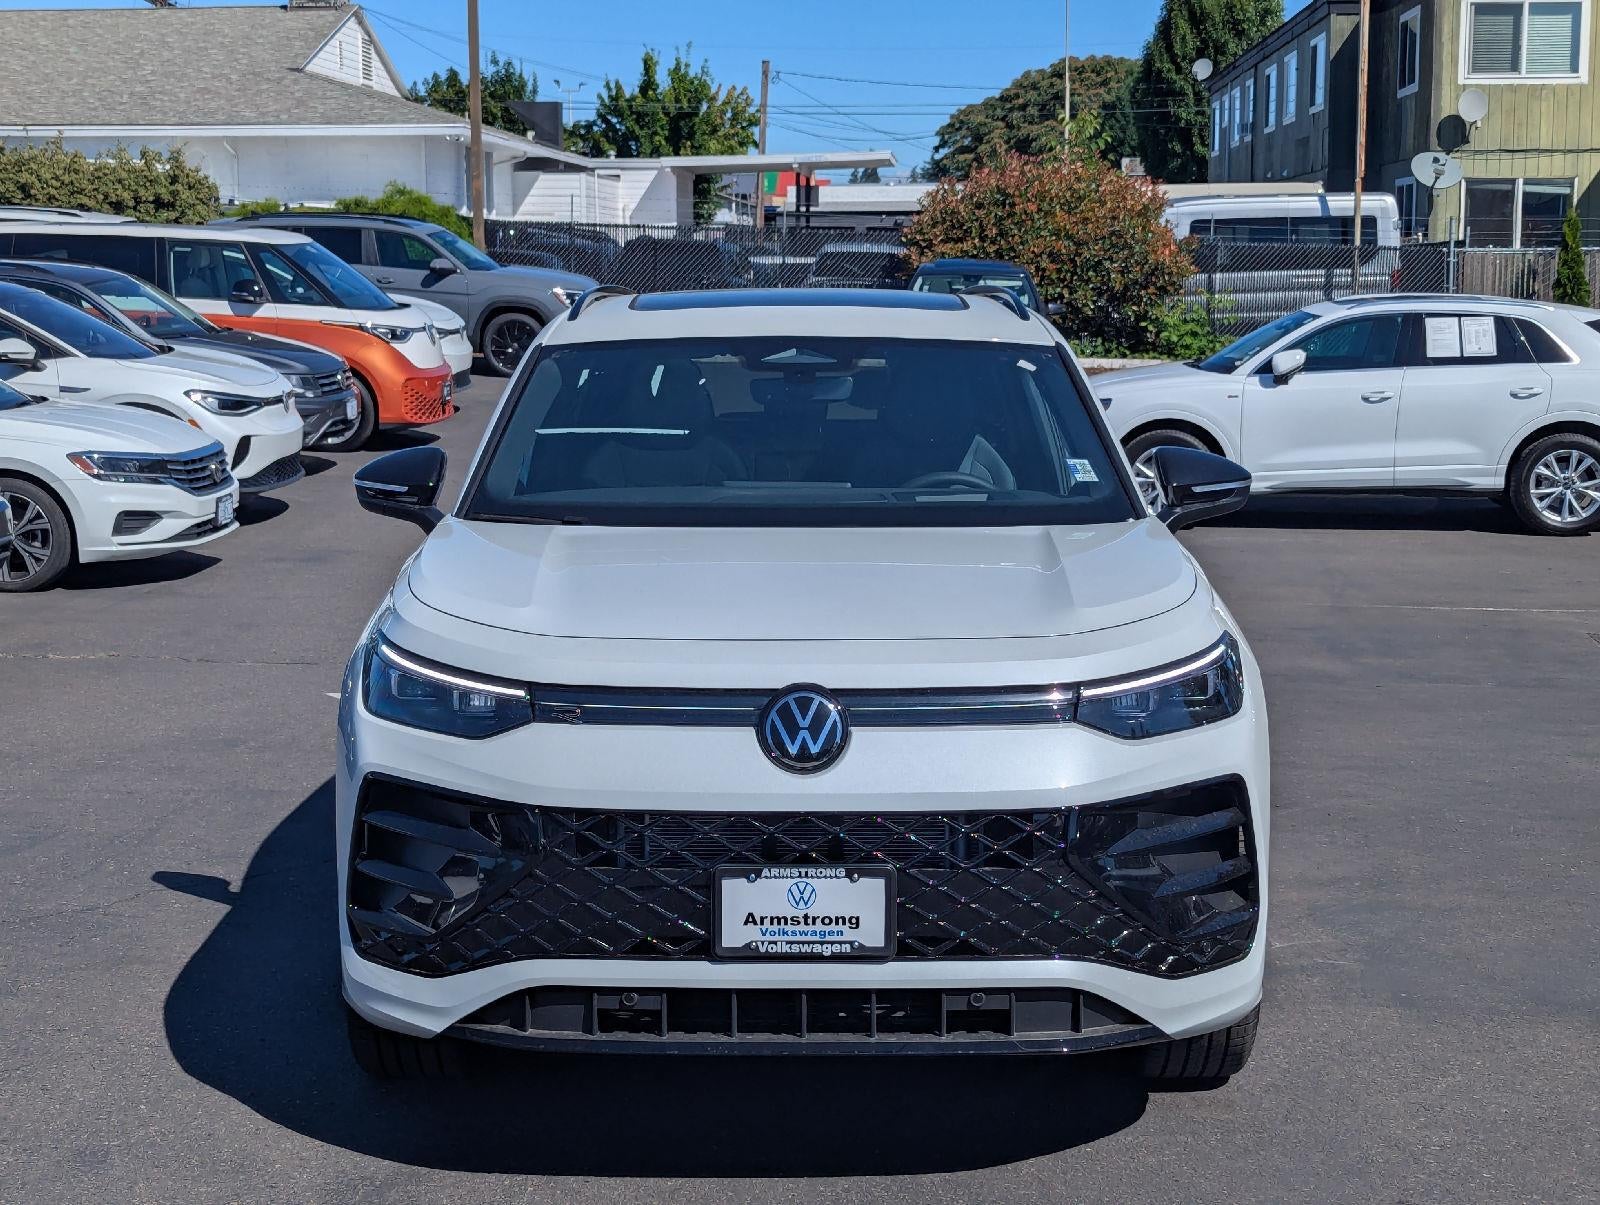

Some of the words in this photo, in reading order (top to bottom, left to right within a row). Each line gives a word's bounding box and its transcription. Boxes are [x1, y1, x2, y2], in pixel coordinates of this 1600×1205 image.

[761, 867, 846, 878] ARMSTRONG
[743, 912, 860, 929] Armstrong
[759, 927, 844, 939] Volkswagen
[756, 941, 851, 956] Volkswagen
